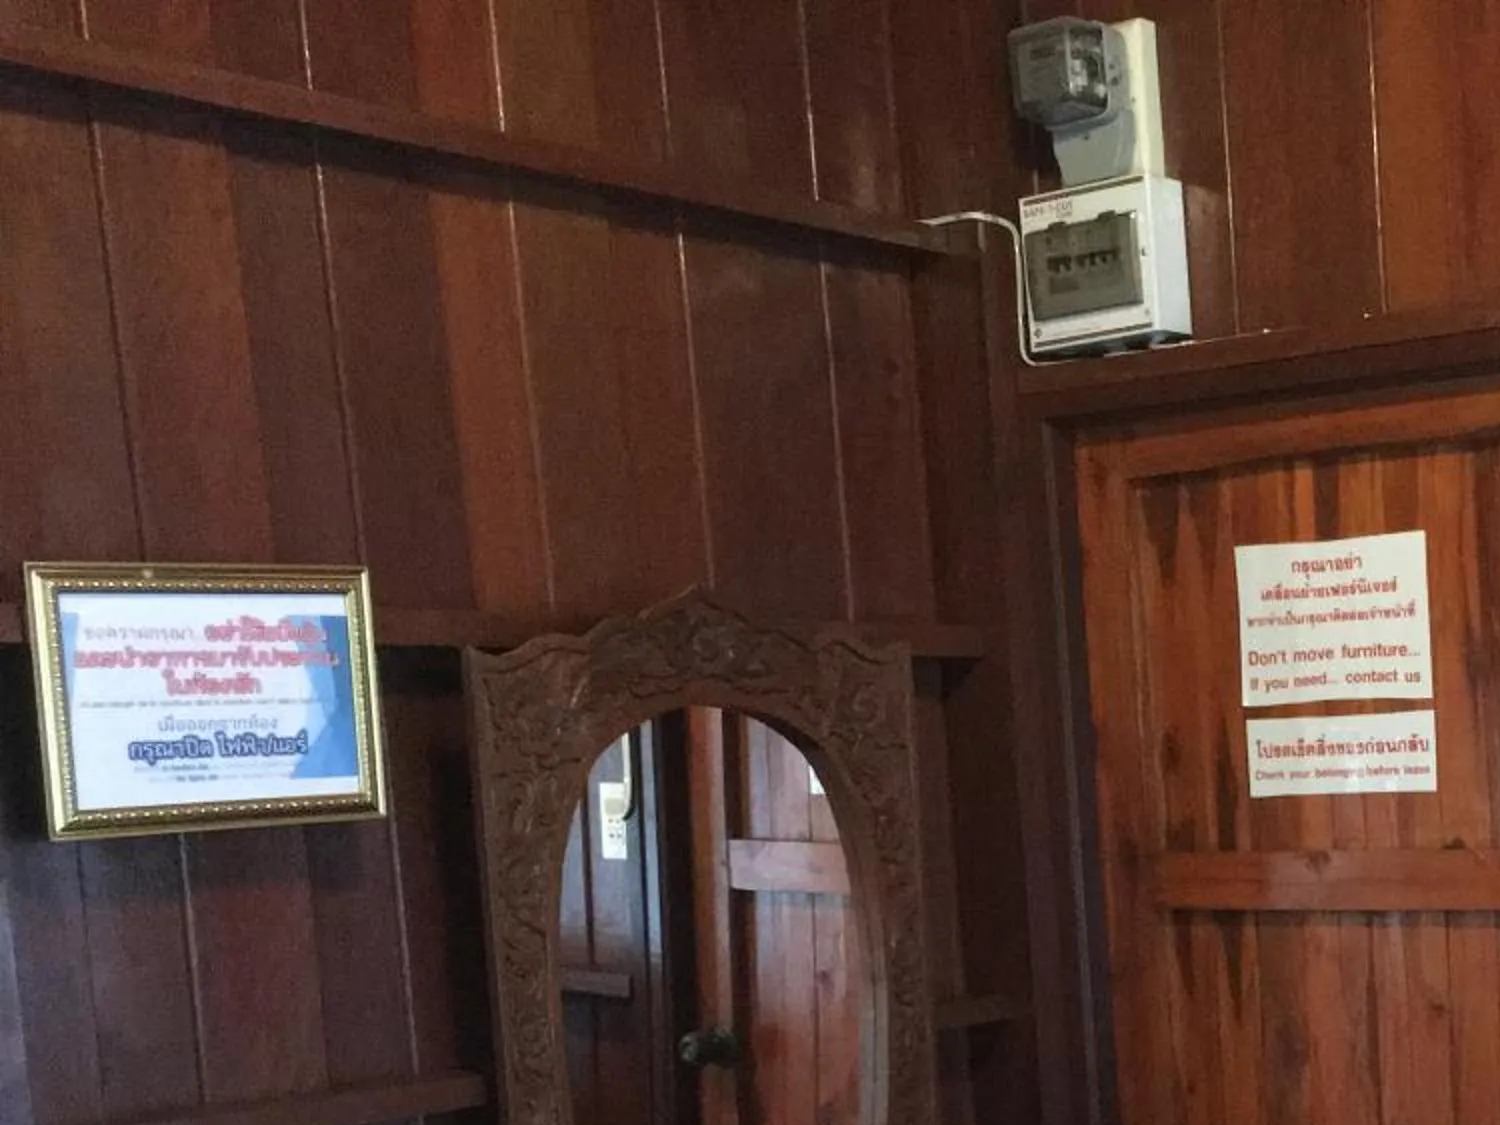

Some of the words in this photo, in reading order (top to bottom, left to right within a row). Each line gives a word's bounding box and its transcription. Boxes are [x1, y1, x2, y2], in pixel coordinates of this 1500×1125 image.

[1291, 551, 1362, 580] กรุณาอย่า
[1249, 649, 1287, 667] Don't
[1293, 648, 1334, 664] move
[1264, 676, 1289, 693] you
[1345, 669, 1399, 684] contact
[1405, 671, 1421, 684] us
